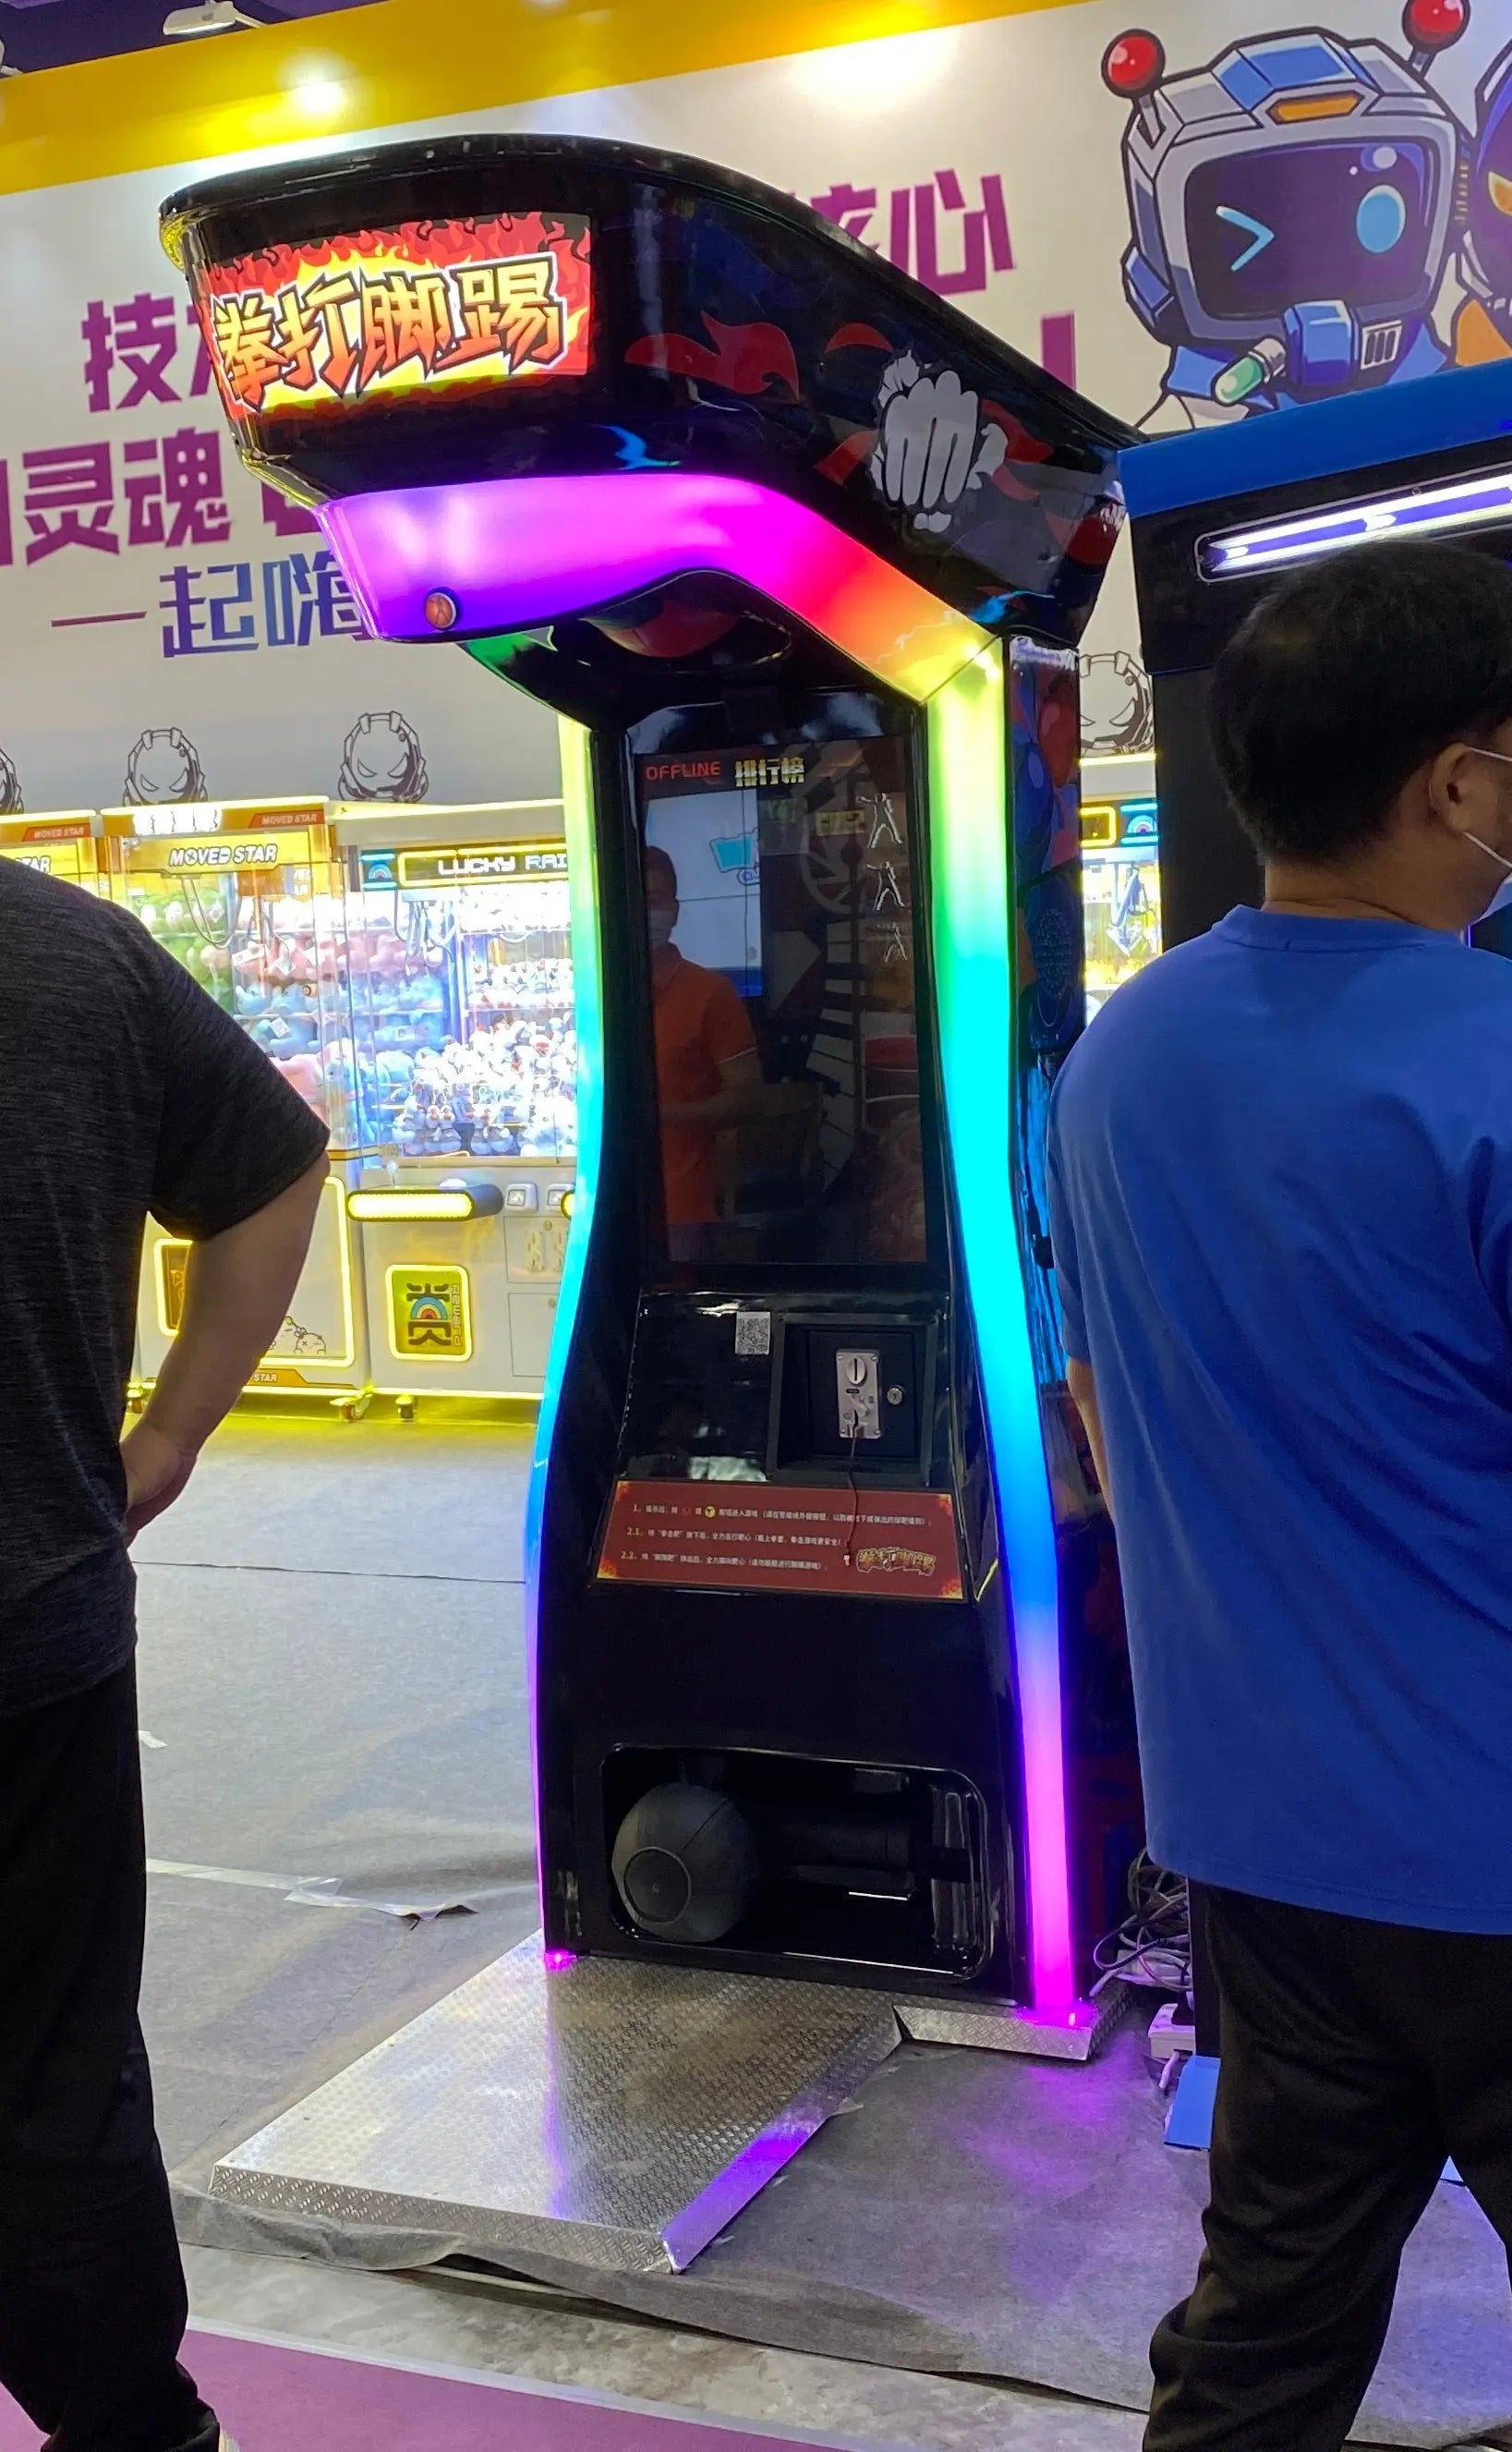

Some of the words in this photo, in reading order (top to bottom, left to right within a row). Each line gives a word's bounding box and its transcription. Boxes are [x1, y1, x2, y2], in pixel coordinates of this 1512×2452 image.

[212, 254, 565, 413] 拳打脚踢
[81, 293, 224, 412] 技
[0, 427, 232, 567] 灵魂
[647, 760, 721, 781] OFFLINE
[262, 815, 295, 825] MOVED
[296, 812, 318, 823] STAR
[33, 830, 62, 840] MOVED
[63, 827, 85, 836] STAR
[16, 856, 51, 873] TAR
[169, 847, 233, 867] MOVED
[233, 844, 278, 863] STAR
[438, 856, 515, 875] LUCKY
[253, 1373, 277, 1382] STAR
